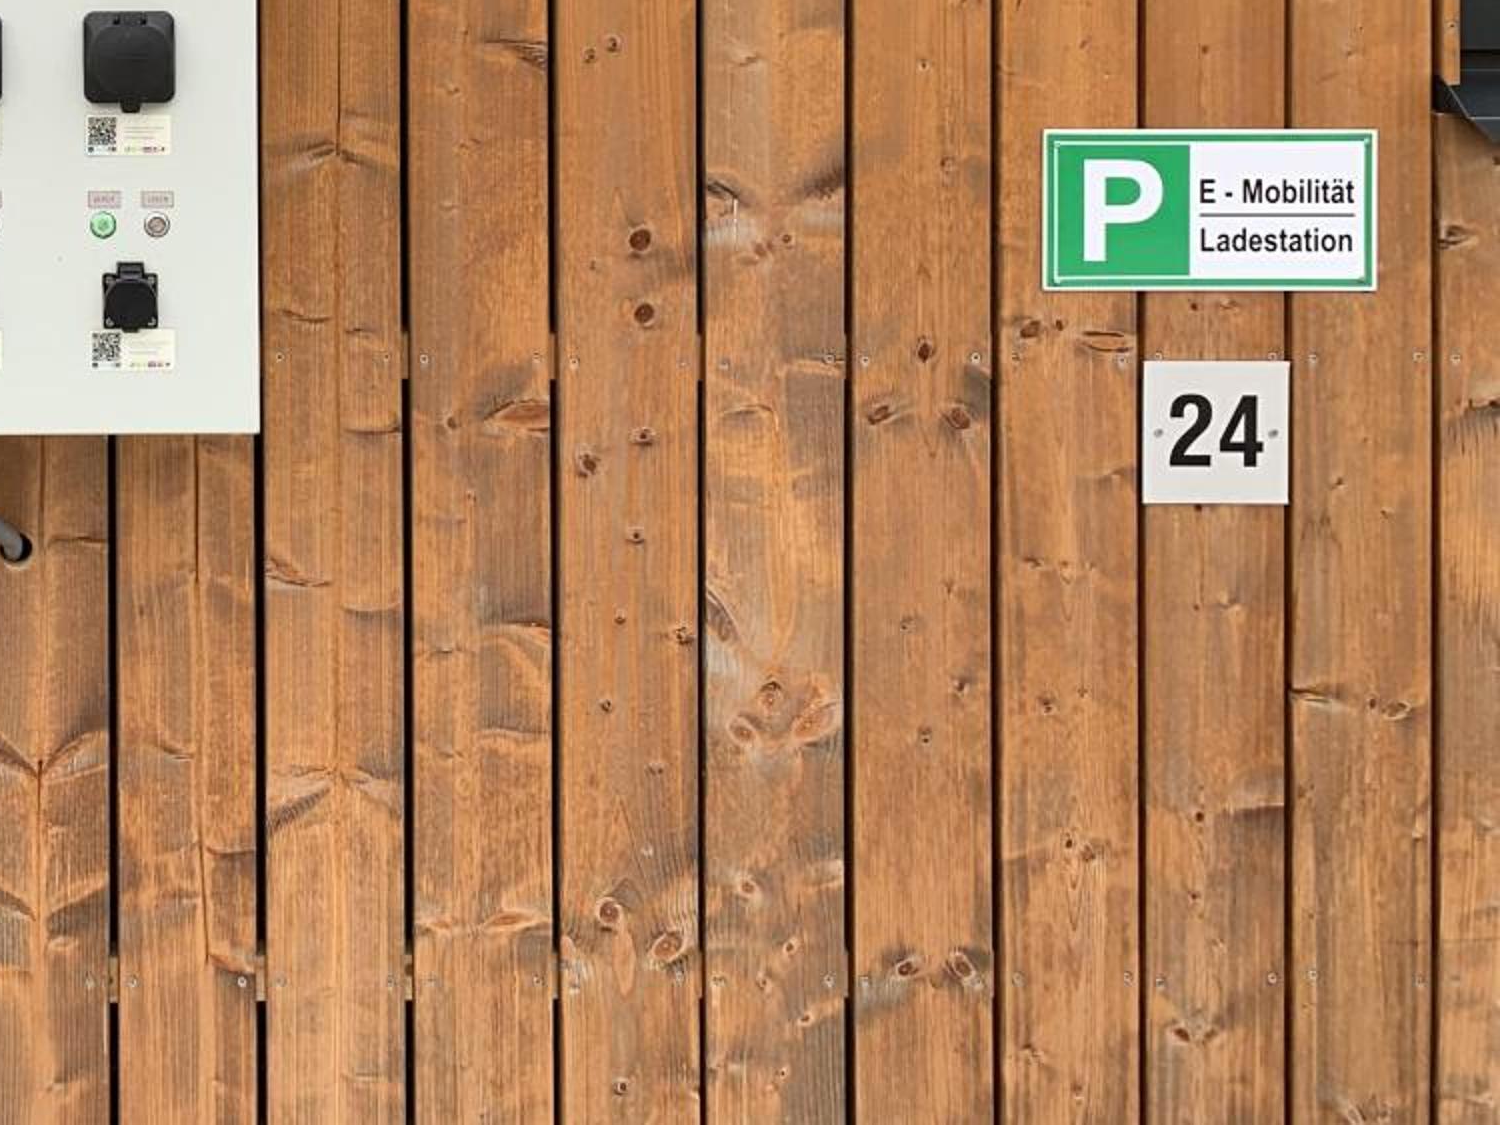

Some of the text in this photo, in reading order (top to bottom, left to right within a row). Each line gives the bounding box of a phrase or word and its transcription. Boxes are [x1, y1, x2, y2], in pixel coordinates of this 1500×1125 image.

[1083, 158, 1163, 262] P
[1199, 179, 1216, 204] E
[1242, 178, 1355, 204] Mobilität
[1200, 228, 1353, 253] Ladestation
[1169, 393, 1264, 468] 24
